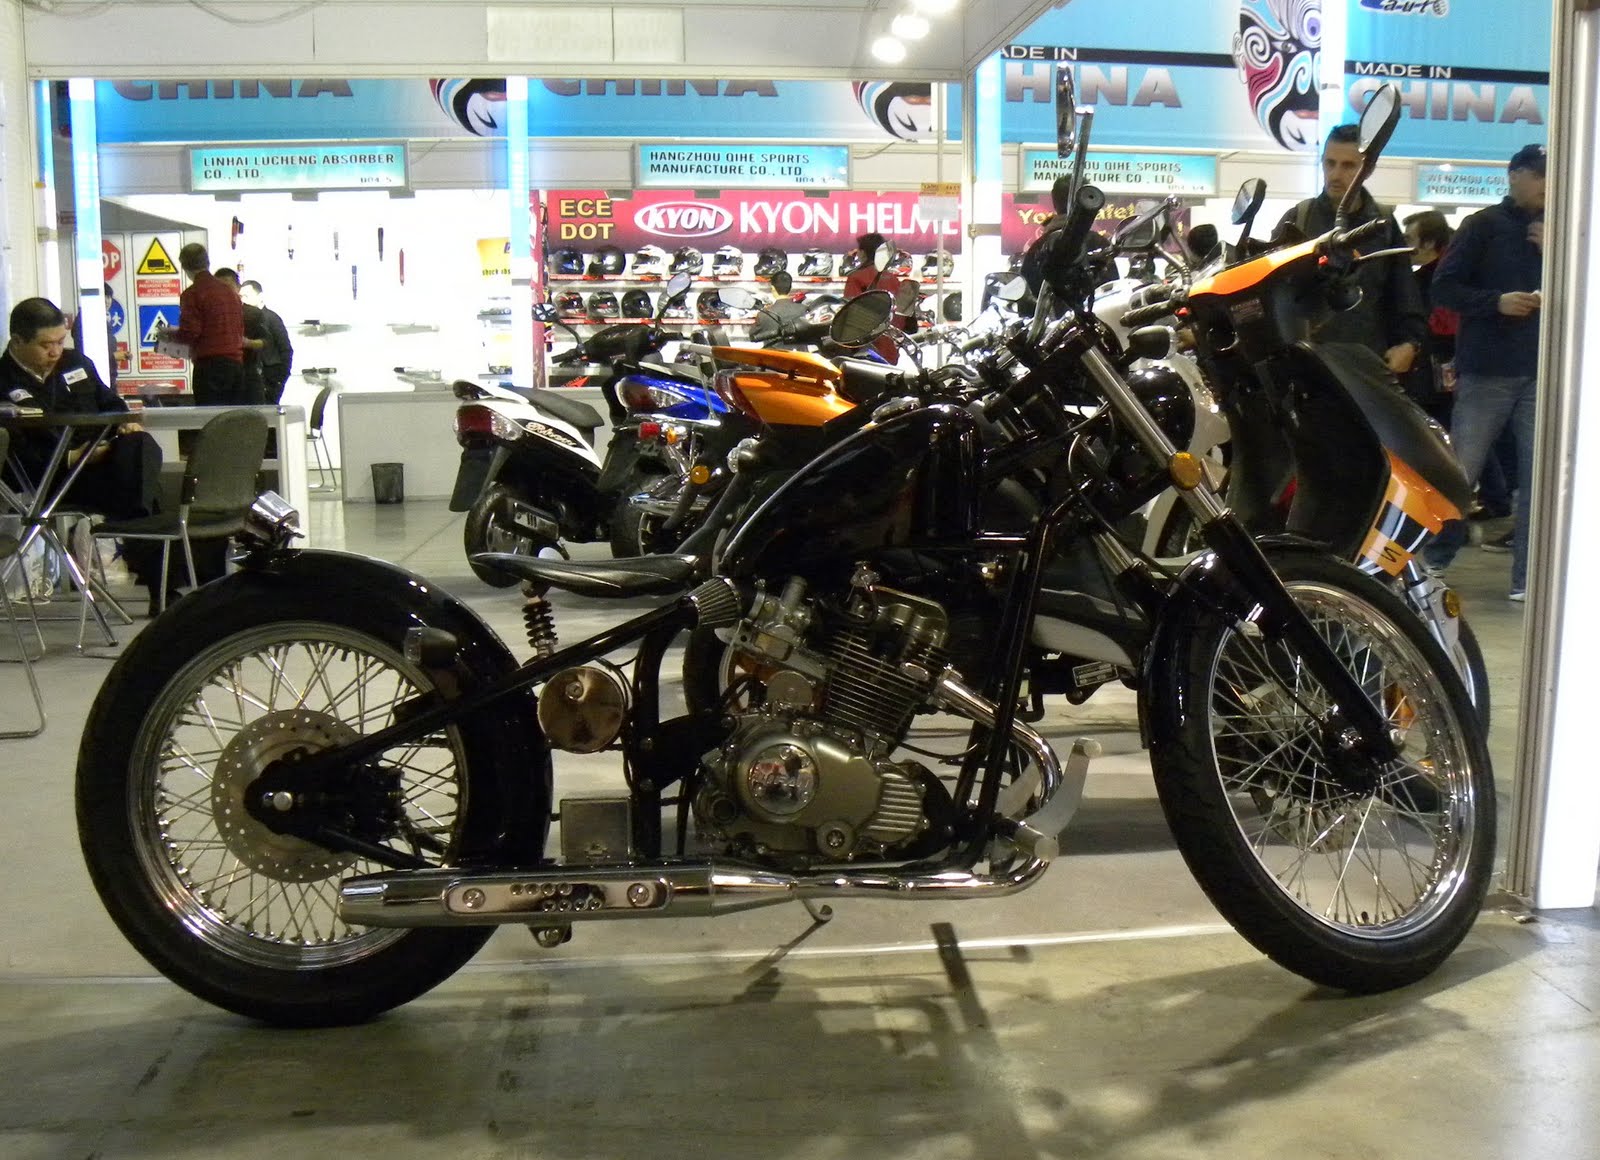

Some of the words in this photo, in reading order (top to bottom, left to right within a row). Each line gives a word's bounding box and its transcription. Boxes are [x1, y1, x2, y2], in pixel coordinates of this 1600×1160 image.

[1000, 45, 1045, 59] ADE
[1054, 47, 1078, 60] IN
[1355, 61, 1423, 78] MADE
[1429, 65, 1452, 79] IN
[1005, 61, 1183, 108] HNA
[203, 156, 249, 167] LINHAI
[254, 155, 317, 166] LUCHENG
[322, 153, 394, 165] ABSORBER
[650, 151, 721, 162] HANGZHOU
[726, 152, 756, 163] QIHE
[761, 153, 810, 164] SPORTS
[650, 163, 745, 175] MANUFACTURE
[1034, 160, 1100, 170] HANGZOU
[1137, 162, 1182, 173] SPORTS
[1034, 171, 1122, 182] MANCTURE
[1426, 185, 1490, 197] INDUSTRIAL
[560, 199, 612, 217] ECE
[649, 207, 716, 231] KYON
[739, 201, 839, 234] KYON
[849, 202, 961, 235] HELM
[560, 223, 614, 240] DOT
[102, 252, 120, 268] OP
